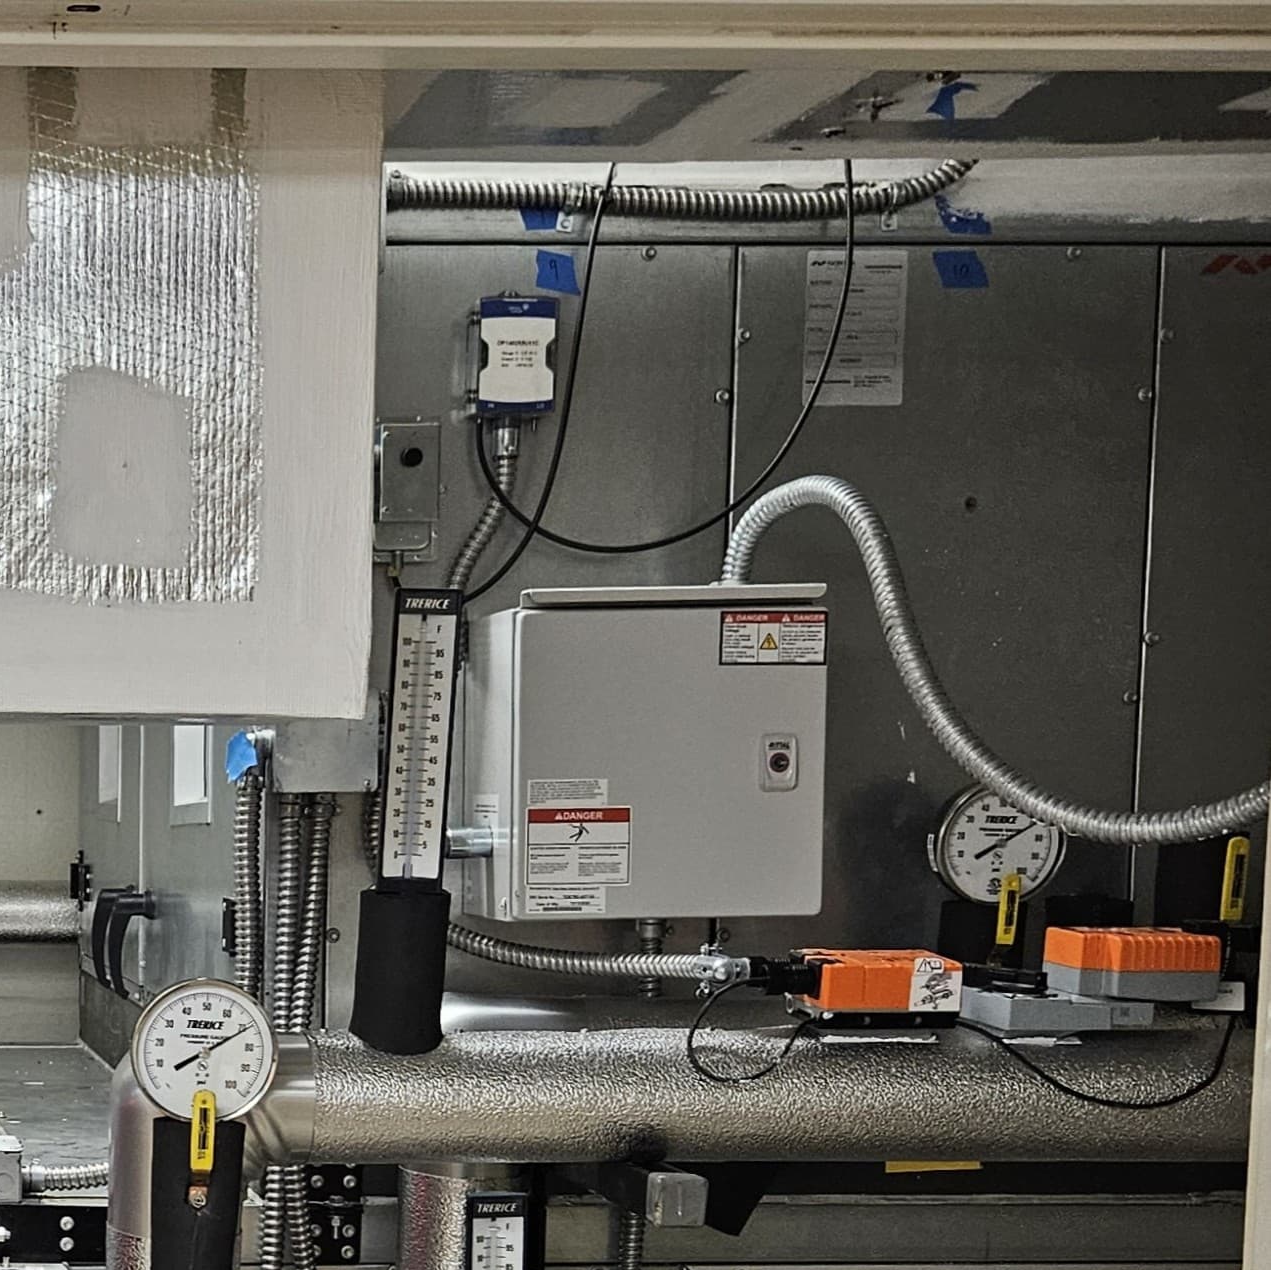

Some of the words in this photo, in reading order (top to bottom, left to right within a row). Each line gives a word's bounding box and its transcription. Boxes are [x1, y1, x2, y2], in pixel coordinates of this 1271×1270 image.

[404, 598, 450, 610] TRERICE
[436, 624, 442, 634] F
[434, 692, 442, 701] 75
[400, 702, 408, 711] 70
[430, 734, 438, 744] 55
[430, 756, 438, 765] 45
[562, 811, 604, 820] DANGER
[182, 1006, 192, 1016] 40
[202, 1002, 212, 1011] 50
[222, 1009, 232, 1018] 60
[164, 1019, 174, 1028] 30
[186, 1019, 225, 1030] TRERICE
[155, 1038, 164, 1046] 20
[244, 1043, 254, 1052] 80
[156, 1059, 164, 1067] 10
[241, 1064, 250, 1072] 90
[225, 1080, 237, 1090] 100
[476, 1203, 518, 1214] TRERICE
